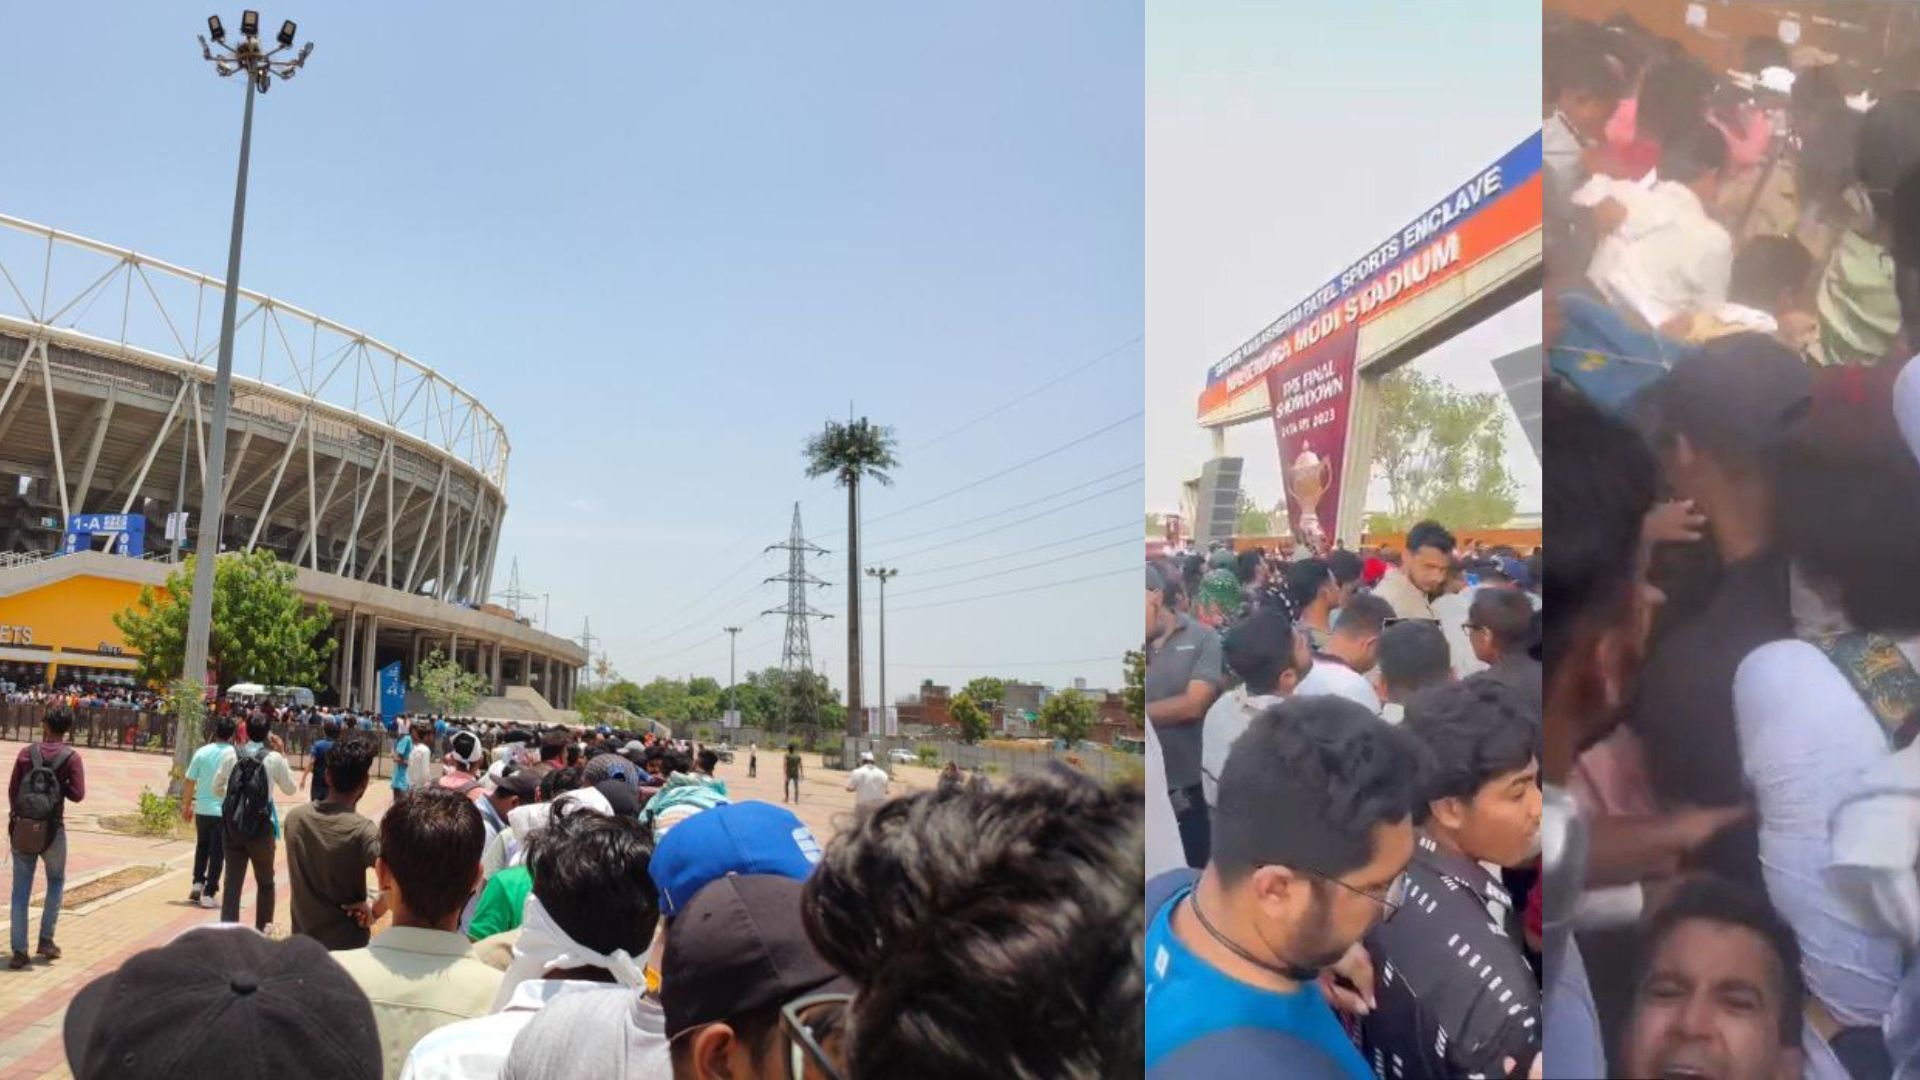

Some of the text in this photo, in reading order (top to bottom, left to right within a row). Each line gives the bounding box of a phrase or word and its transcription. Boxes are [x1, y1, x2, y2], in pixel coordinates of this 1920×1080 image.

[1341, 236, 1399, 293] SPORTS
[1403, 166, 1502, 250] ENCLAVE
[1294, 306, 1341, 353] MODI
[1344, 231, 1460, 323] STADIUM
[73, 517, 100, 530] 1-A
